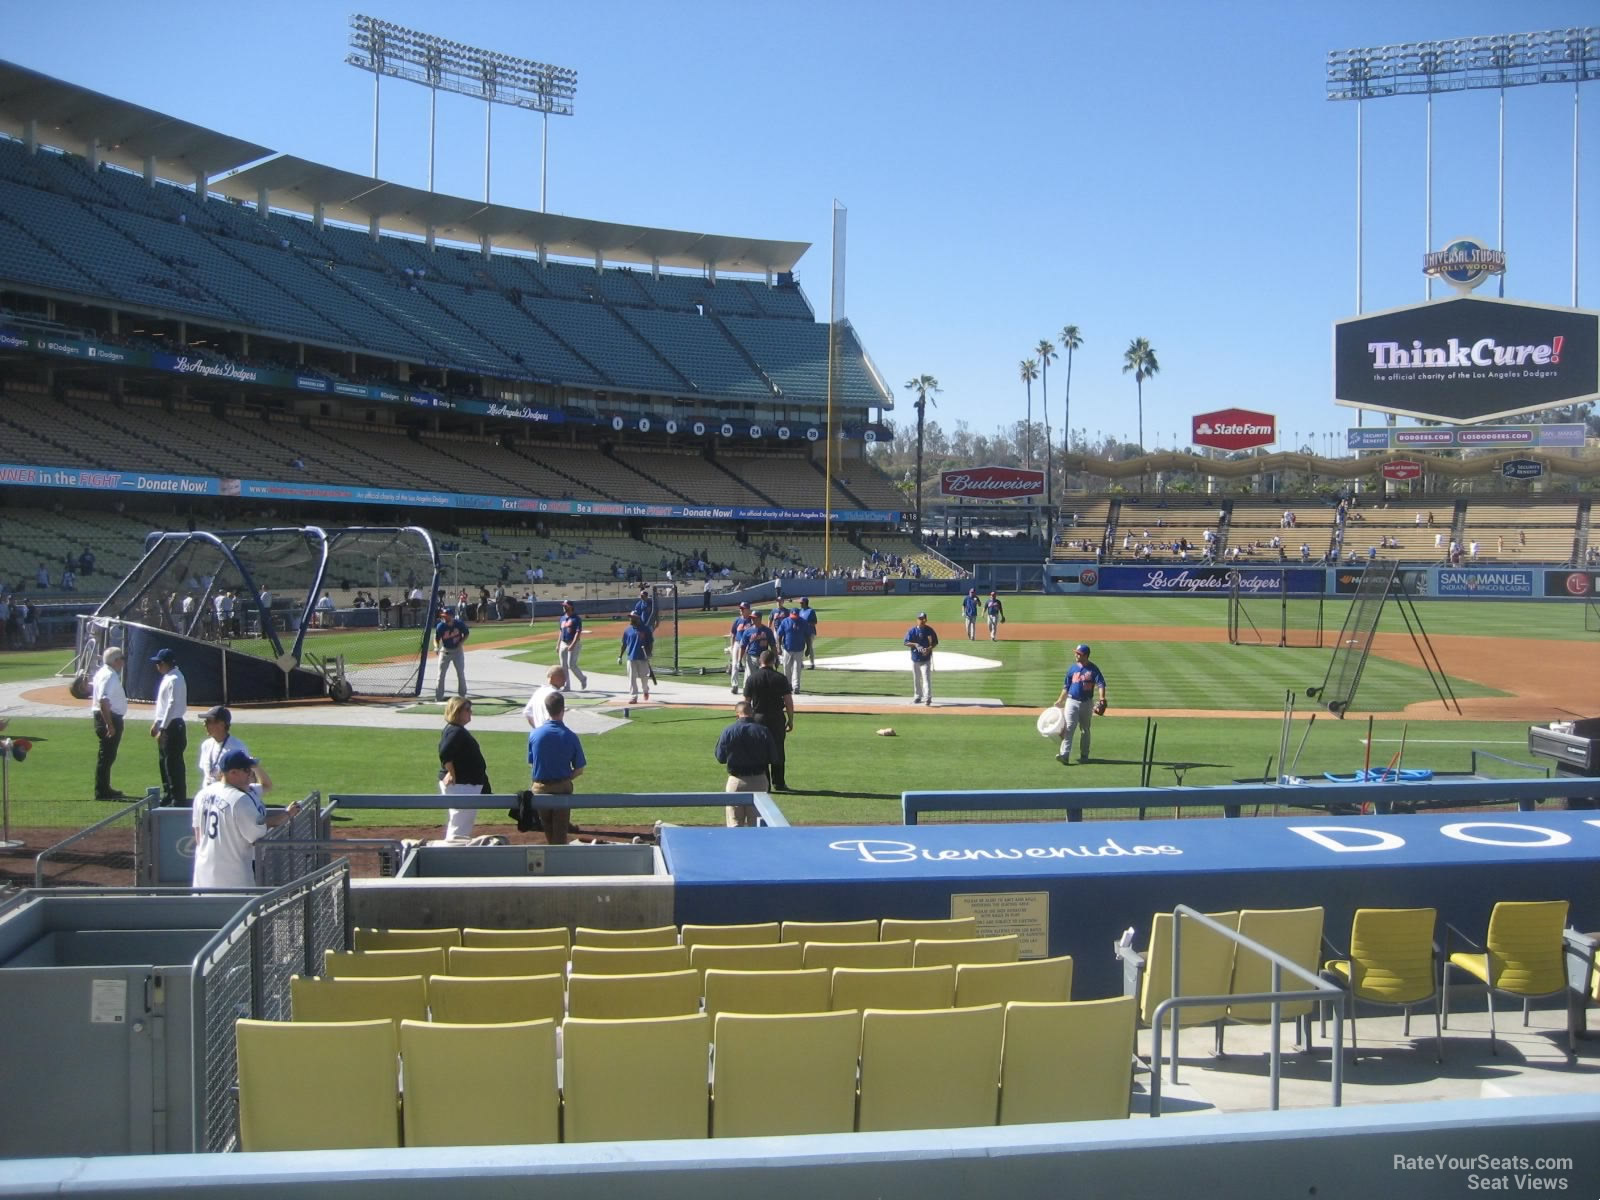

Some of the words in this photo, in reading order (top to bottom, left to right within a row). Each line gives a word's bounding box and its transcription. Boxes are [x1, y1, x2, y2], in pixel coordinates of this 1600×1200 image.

[1423, 250, 1469, 267] UNIVERSAL
[1472, 249, 1505, 265] STUDIOS
[1433, 264, 1494, 272] HOLLYWOOD
[1368, 336, 1563, 369] ThinkCure!
[173, 357, 190, 373] Los
[189, 359, 223, 377] Angeles
[222, 363, 257, 381] Dodgers
[1388, 372, 1415, 380] official
[1418, 372, 1445, 382] charity
[1458, 371, 1470, 379] the
[1473, 371, 1485, 379] Los
[1488, 371, 1520, 380] Angeles
[1523, 370, 1558, 378] Dodgers
[487, 403, 501, 416] Los
[499, 404, 522, 419] Angeles
[521, 407, 548, 421] Dodgers
[39, 470, 52, 484] in
[55, 471, 77, 486] the
[79, 472, 122, 488] FIGHT
[137, 477, 178, 491] Donate
[180, 479, 208, 493] Now!
[946, 474, 1041, 491] Budweiser
[501, 498, 517, 510] Text
[539, 501, 547, 511] to
[577, 503, 586, 513] Be
[624, 505, 632, 515] in
[633, 506, 646, 516] the
[682, 507, 711, 517] Donate
[712, 508, 733, 518] Now!
[763, 510, 778, 519] charity
[1143, 570, 1169, 588] Los
[1167, 570, 1222, 592] Angeles
[1222, 571, 1280, 593] Dodgers
[1440, 573, 1467, 584] SAN
[1477, 574, 1530, 585] MANUEL
[203, 808, 219, 840] 13
[1287, 820, 1600, 853] DO
[829, 838, 1184, 863] Bienvenidos
